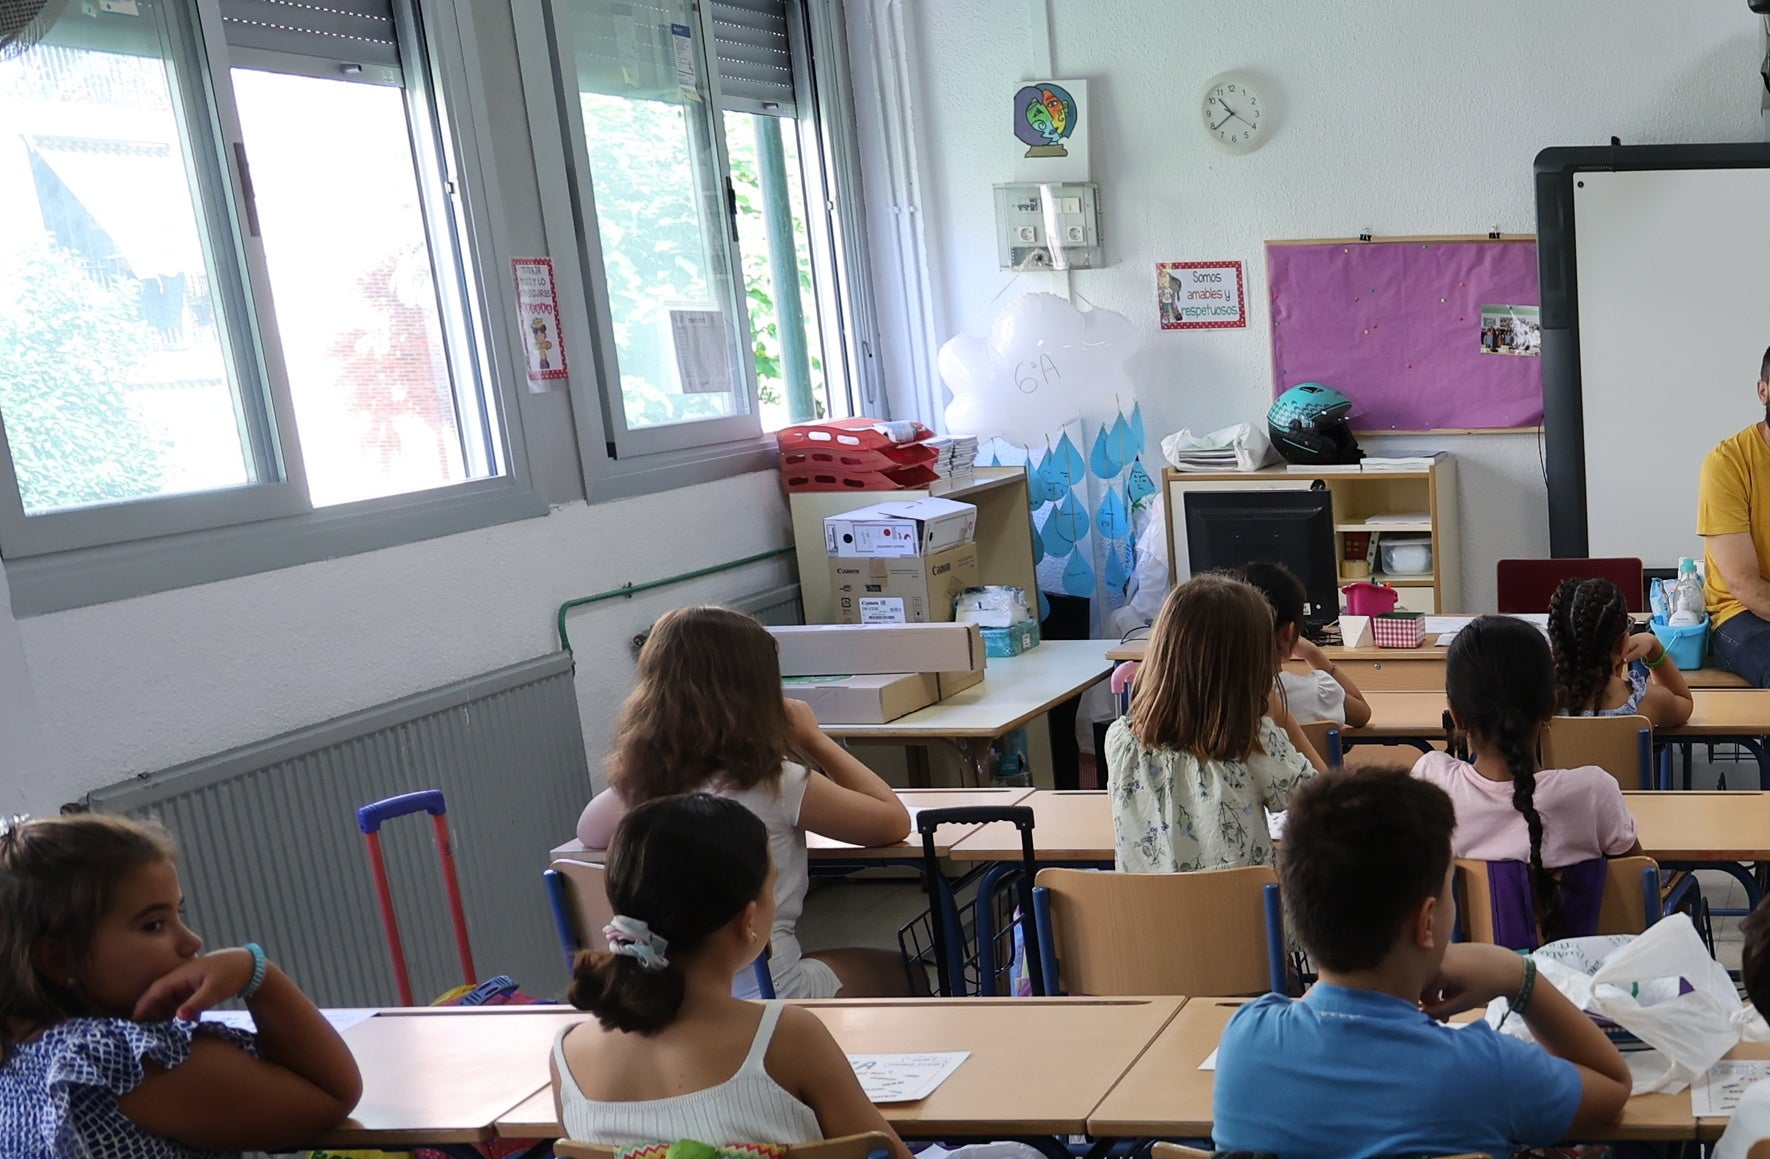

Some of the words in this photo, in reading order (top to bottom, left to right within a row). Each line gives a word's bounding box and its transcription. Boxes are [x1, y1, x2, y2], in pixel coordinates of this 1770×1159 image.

[1228, 84, 1236, 92] 12
[1208, 97, 1216, 105] 10
[1251, 97, 1257, 105] 2
[1206, 109, 1212, 117] 9
[1254, 110, 1260, 118] 3
[1210, 122, 1216, 130] 8
[1251, 122, 1257, 130] 4
[1220, 131, 1225, 139] 7
[1231, 135, 1237, 143] 6
[1243, 131, 1249, 139] 5
[1192, 270, 1222, 283] Somos
[1187, 287, 1223, 300] amables
[1224, 290, 1231, 302] y
[836, 567, 860, 575] Canon
[932, 563, 951, 576] Canon
